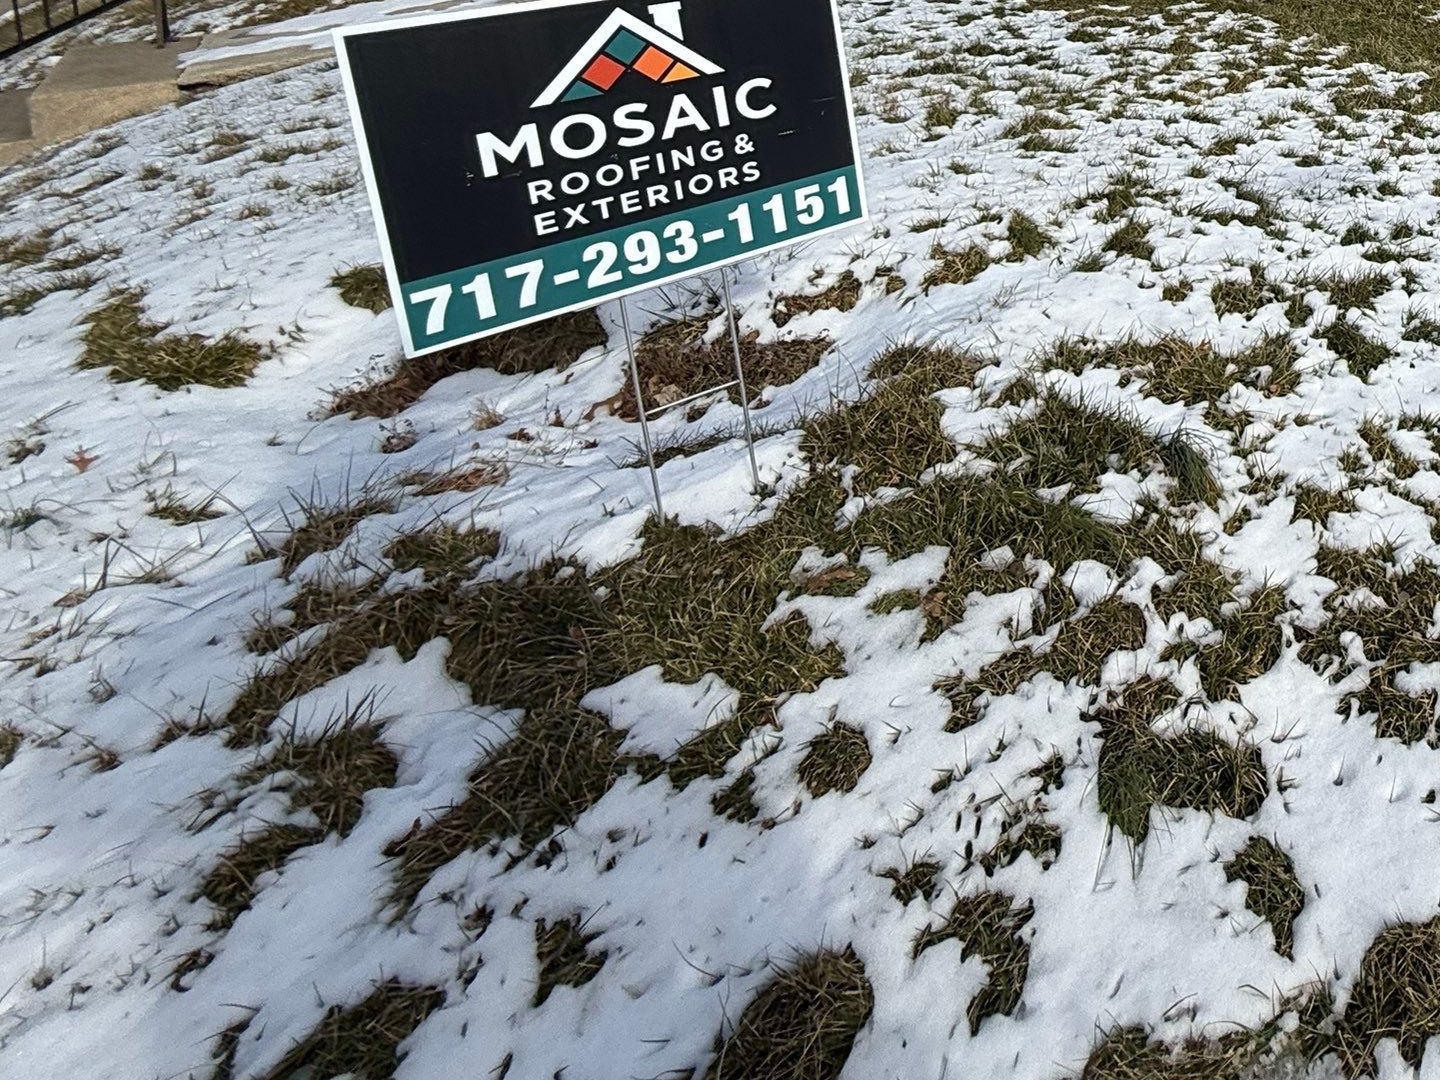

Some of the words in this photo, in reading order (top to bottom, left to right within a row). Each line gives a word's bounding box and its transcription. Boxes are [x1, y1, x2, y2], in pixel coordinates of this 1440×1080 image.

[475, 77, 777, 178] MOSAIC
[527, 139, 725, 204] ROOFING
[734, 133, 755, 156] &
[534, 161, 761, 236] EXTERIORS
[409, 176, 853, 336] 717-293-1151
